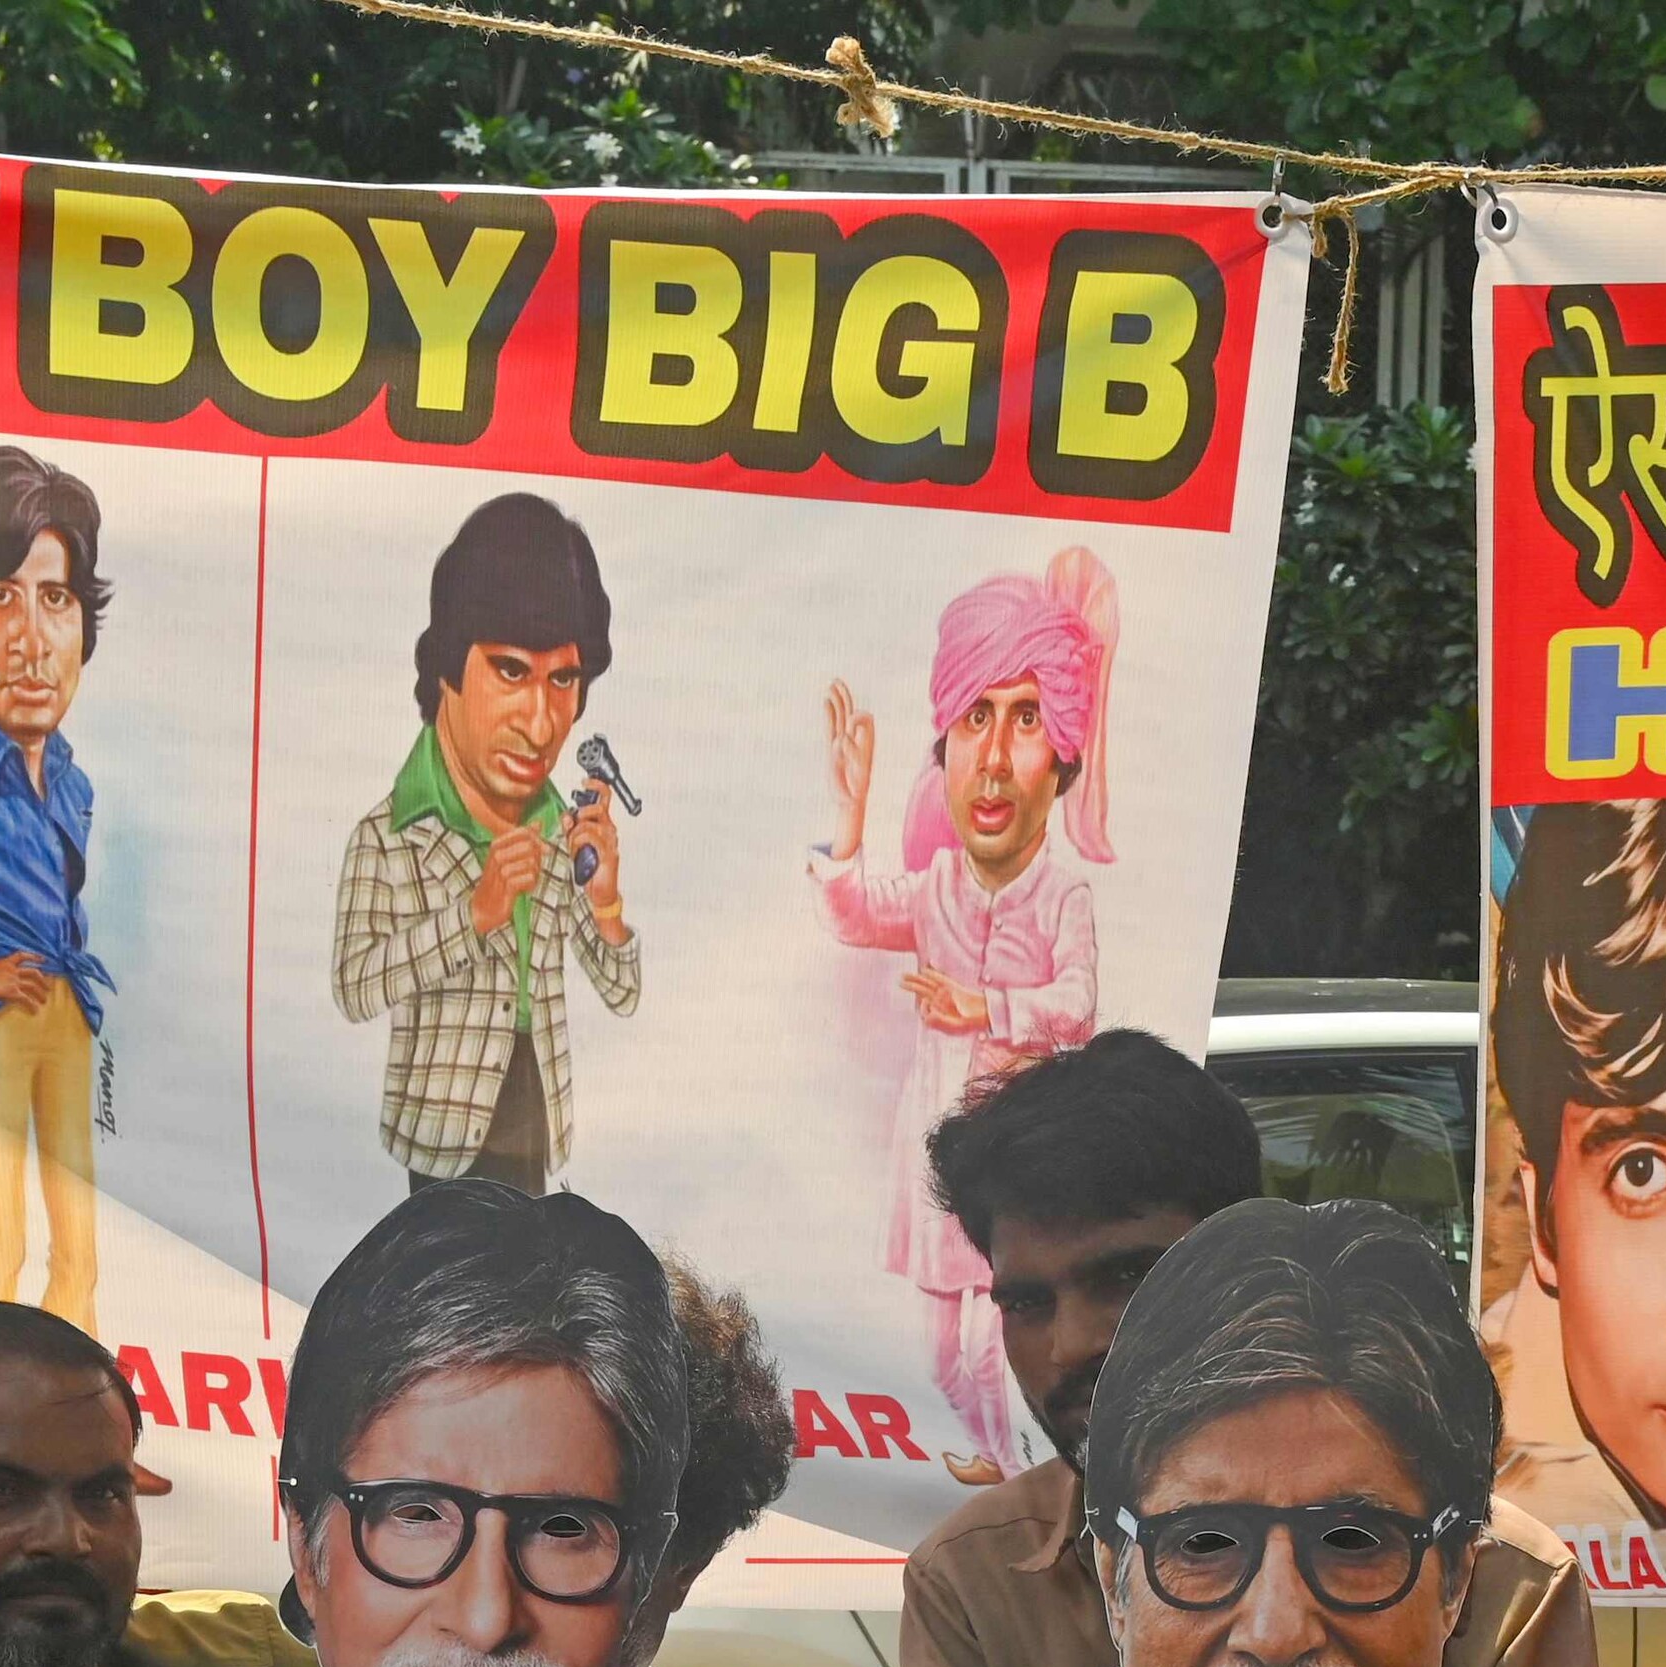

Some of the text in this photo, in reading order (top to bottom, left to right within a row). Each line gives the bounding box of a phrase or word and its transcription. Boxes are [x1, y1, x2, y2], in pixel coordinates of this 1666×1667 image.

[49, 187, 526, 412] BOY
[599, 240, 982, 447] BIG
[1056, 271, 1200, 462] B
